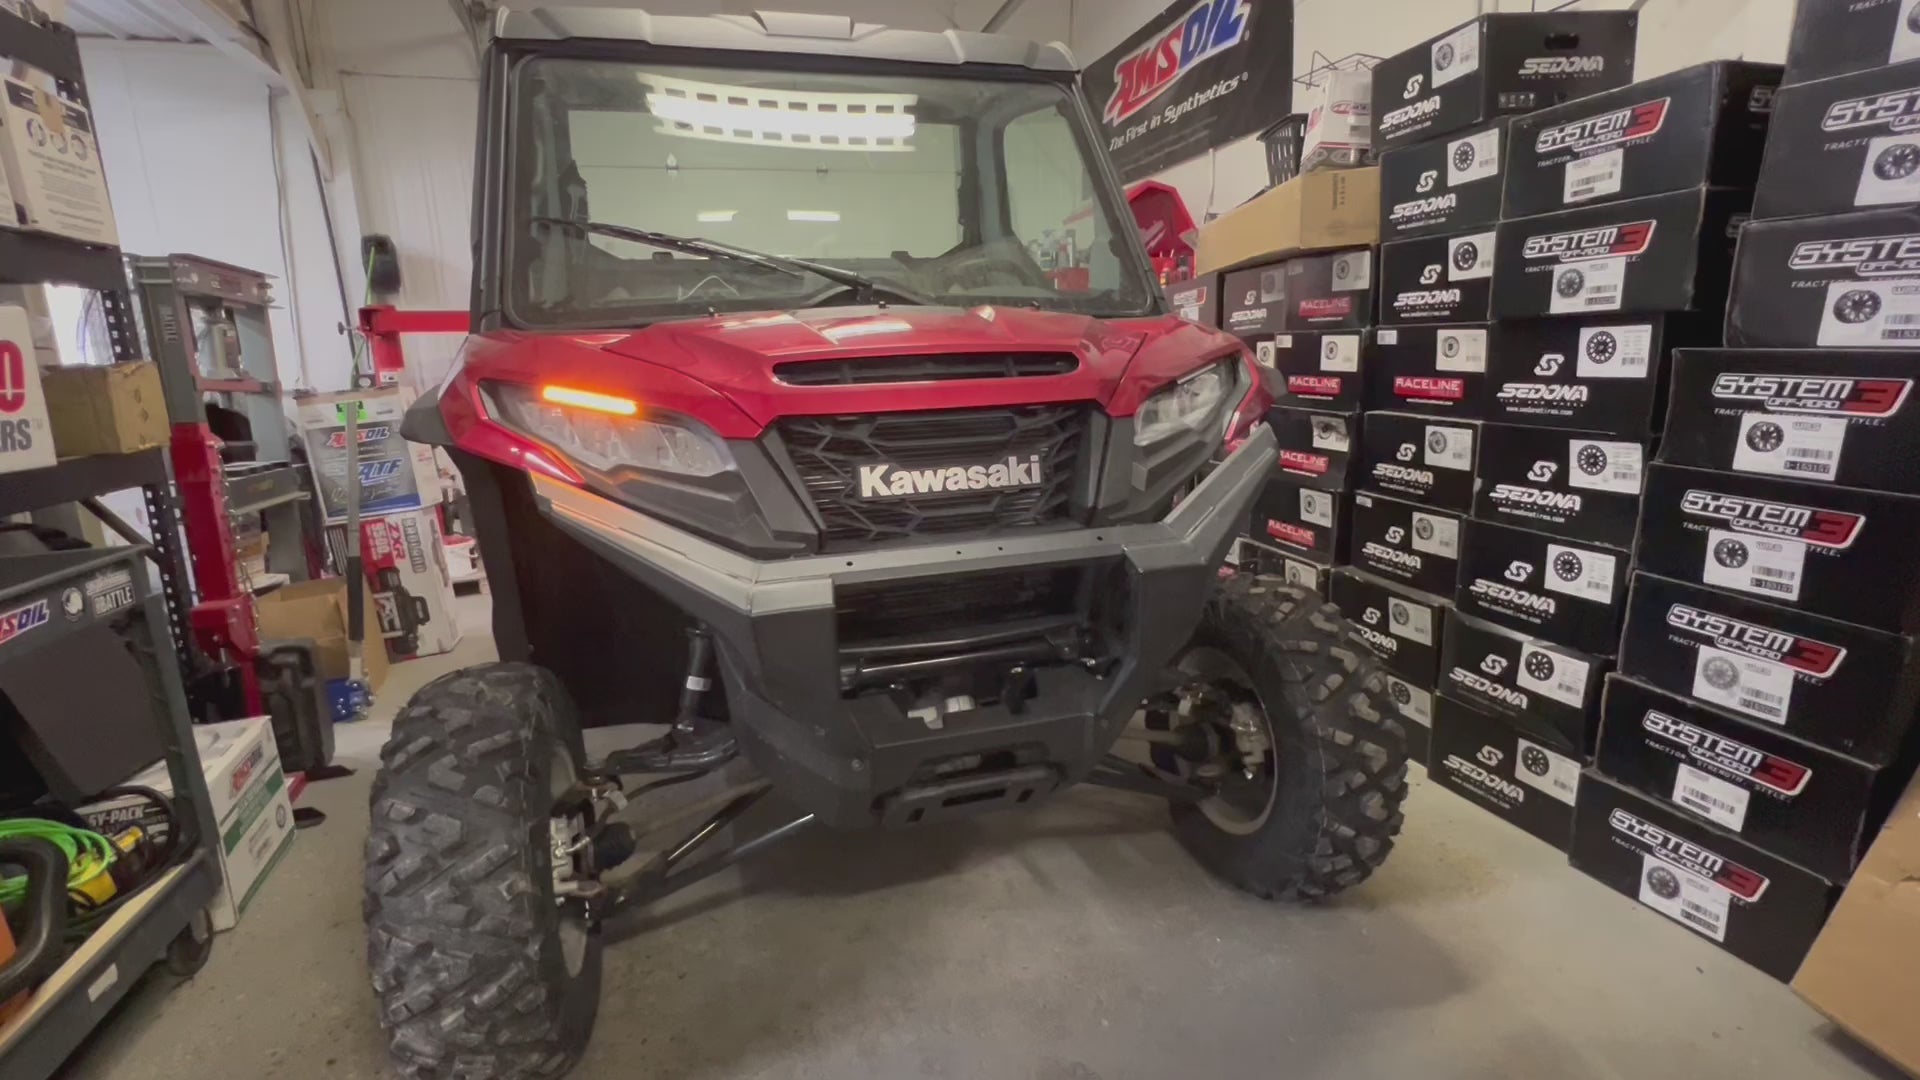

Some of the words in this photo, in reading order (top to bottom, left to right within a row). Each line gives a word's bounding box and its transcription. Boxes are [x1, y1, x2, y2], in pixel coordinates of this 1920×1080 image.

[1102, 0, 1250, 127] AMSOIL
[1518, 55, 1604, 75] SEDONA
[1109, 137, 1124, 151] The
[1126, 120, 1148, 143] First
[1151, 115, 1161, 130] in
[1164, 75, 1240, 124] Synthetics
[1379, 95, 1440, 130] SEDONA
[1538, 109, 1632, 149] SYSTEM
[1625, 99, 1665, 136] 3
[1389, 193, 1456, 220] SEDONA
[1525, 228, 1618, 254] SYSTEM
[1611, 222, 1653, 253] 3
[1300, 298, 1350, 310] RACELINE
[1393, 289, 1461, 307] SEDONA
[1289, 376, 1341, 389] RACELINE
[1395, 377, 1461, 391] RACELINE
[1496, 383, 1588, 401] SEDONA
[1714, 376, 1853, 399] SYSTEM
[1843, 379, 1904, 414] 3
[1767, 398, 1840, 409] OFF-ROAD
[860, 455, 1041, 497] Kawasaki
[1372, 463, 1434, 485] SEDONA
[1488, 484, 1581, 511] SEDONA
[1268, 519, 1316, 541] RACELINE
[1684, 492, 1811, 527] SYSTEM
[1803, 511, 1858, 545] 3
[388, 522, 406, 559] ZXR
[1361, 542, 1421, 569] SEDONA
[1469, 578, 1555, 615] SEDONA
[1669, 607, 1794, 652] SYSTEM
[1783, 639, 1840, 674] 3
[1449, 667, 1528, 709] SEDONA
[1645, 712, 1763, 768] SYSTEM
[1752, 756, 1806, 792] 3
[1442, 754, 1524, 803] SEDONA
[1612, 810, 1723, 873] SYSTEM
[1716, 863, 1763, 899] 3
